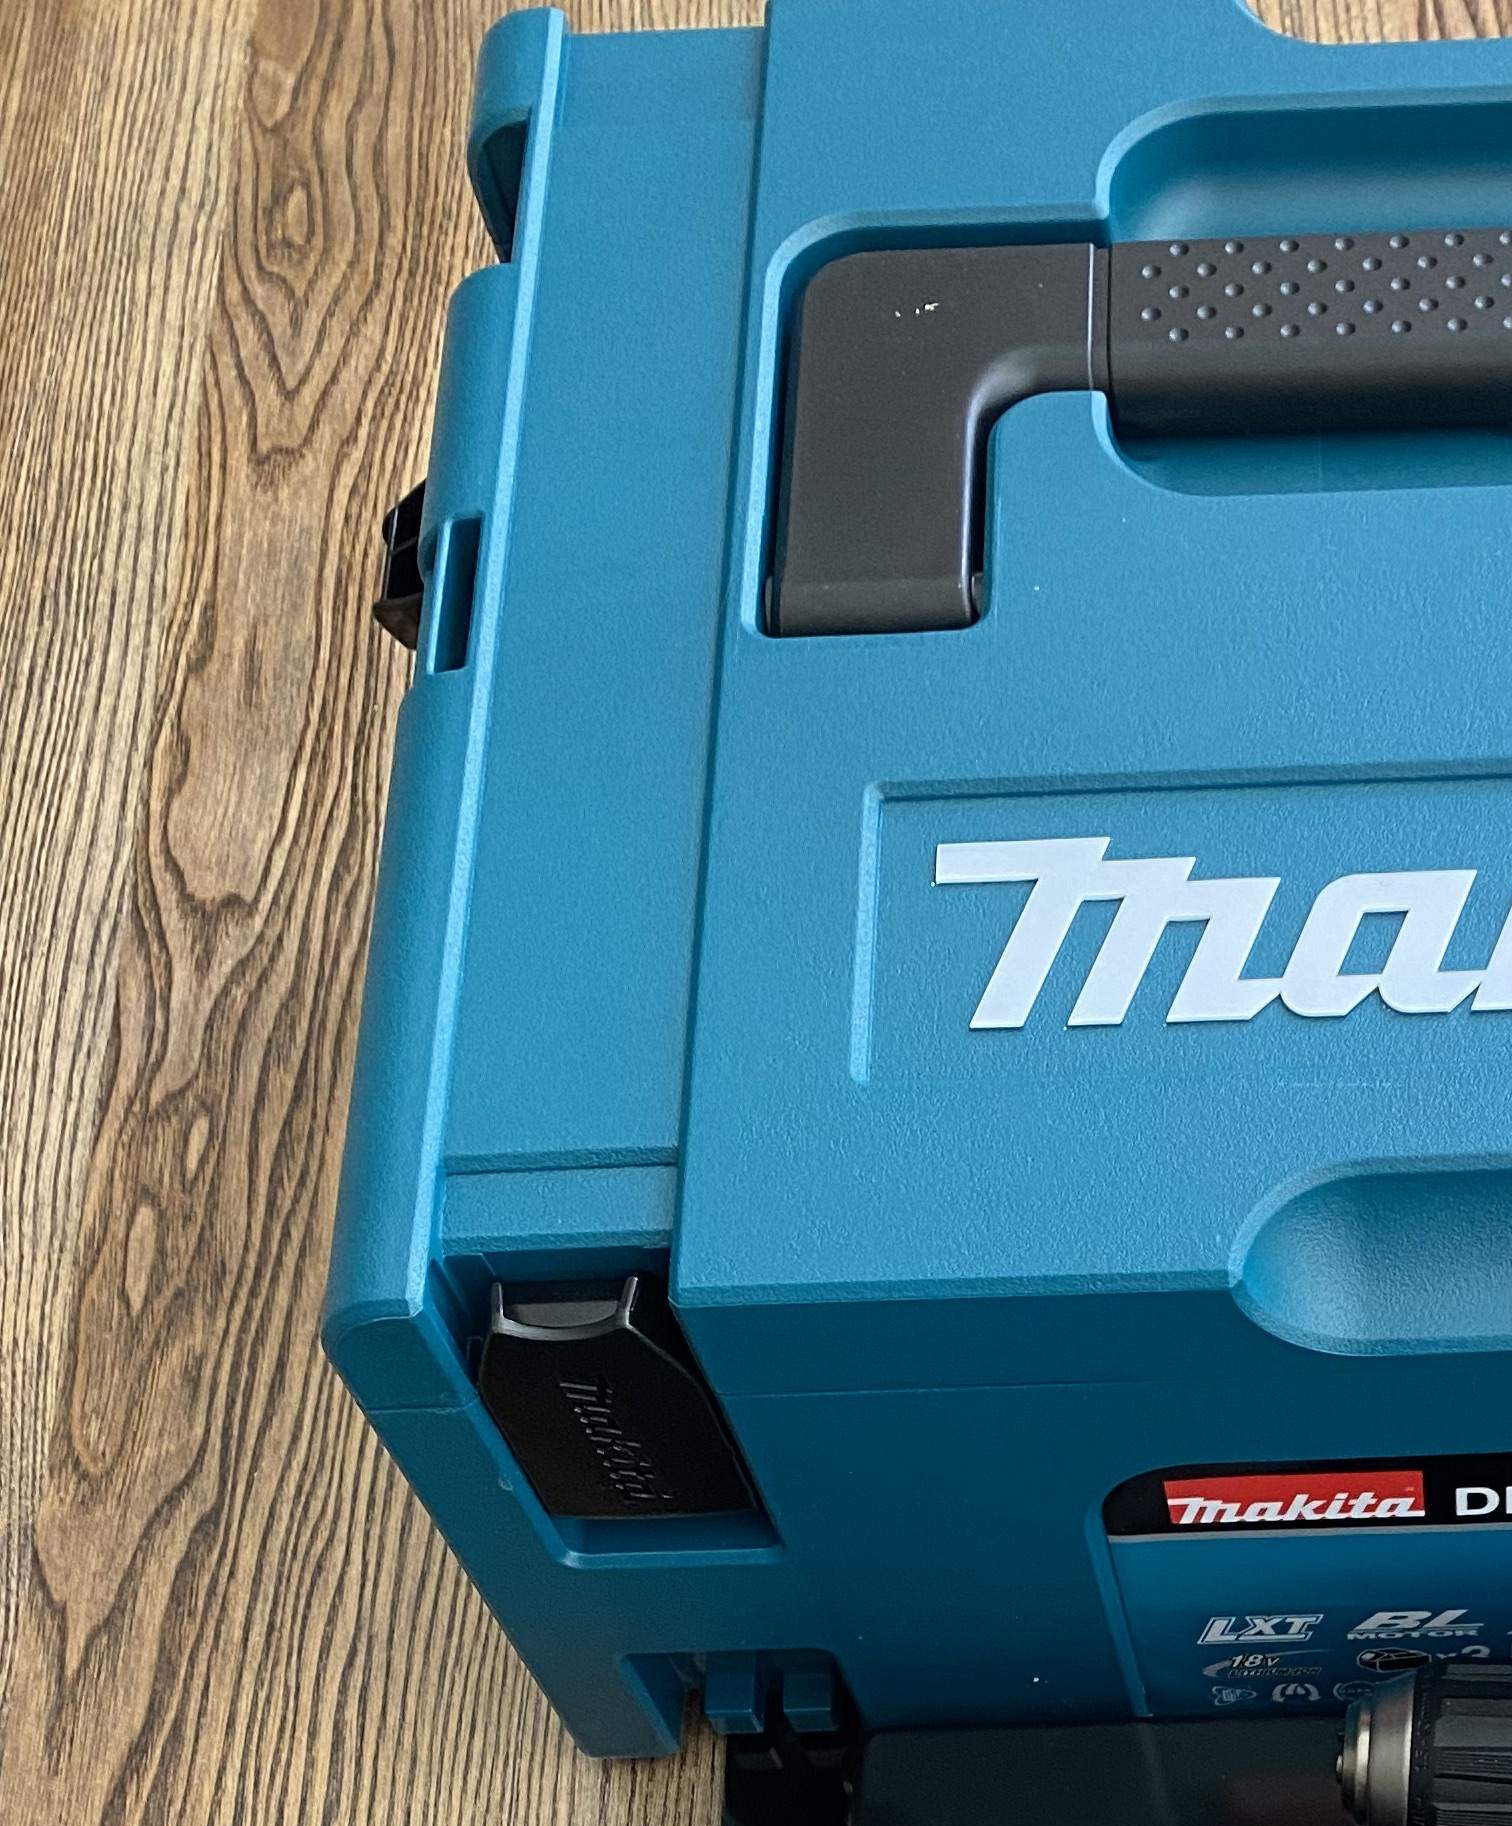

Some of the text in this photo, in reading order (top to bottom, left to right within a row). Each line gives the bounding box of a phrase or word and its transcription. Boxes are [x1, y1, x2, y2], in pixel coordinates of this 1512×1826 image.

[1198, 1614, 1325, 1645] LXT
[1352, 1608, 1485, 1632] BL
[1346, 1629, 1480, 1641] MOTOR
